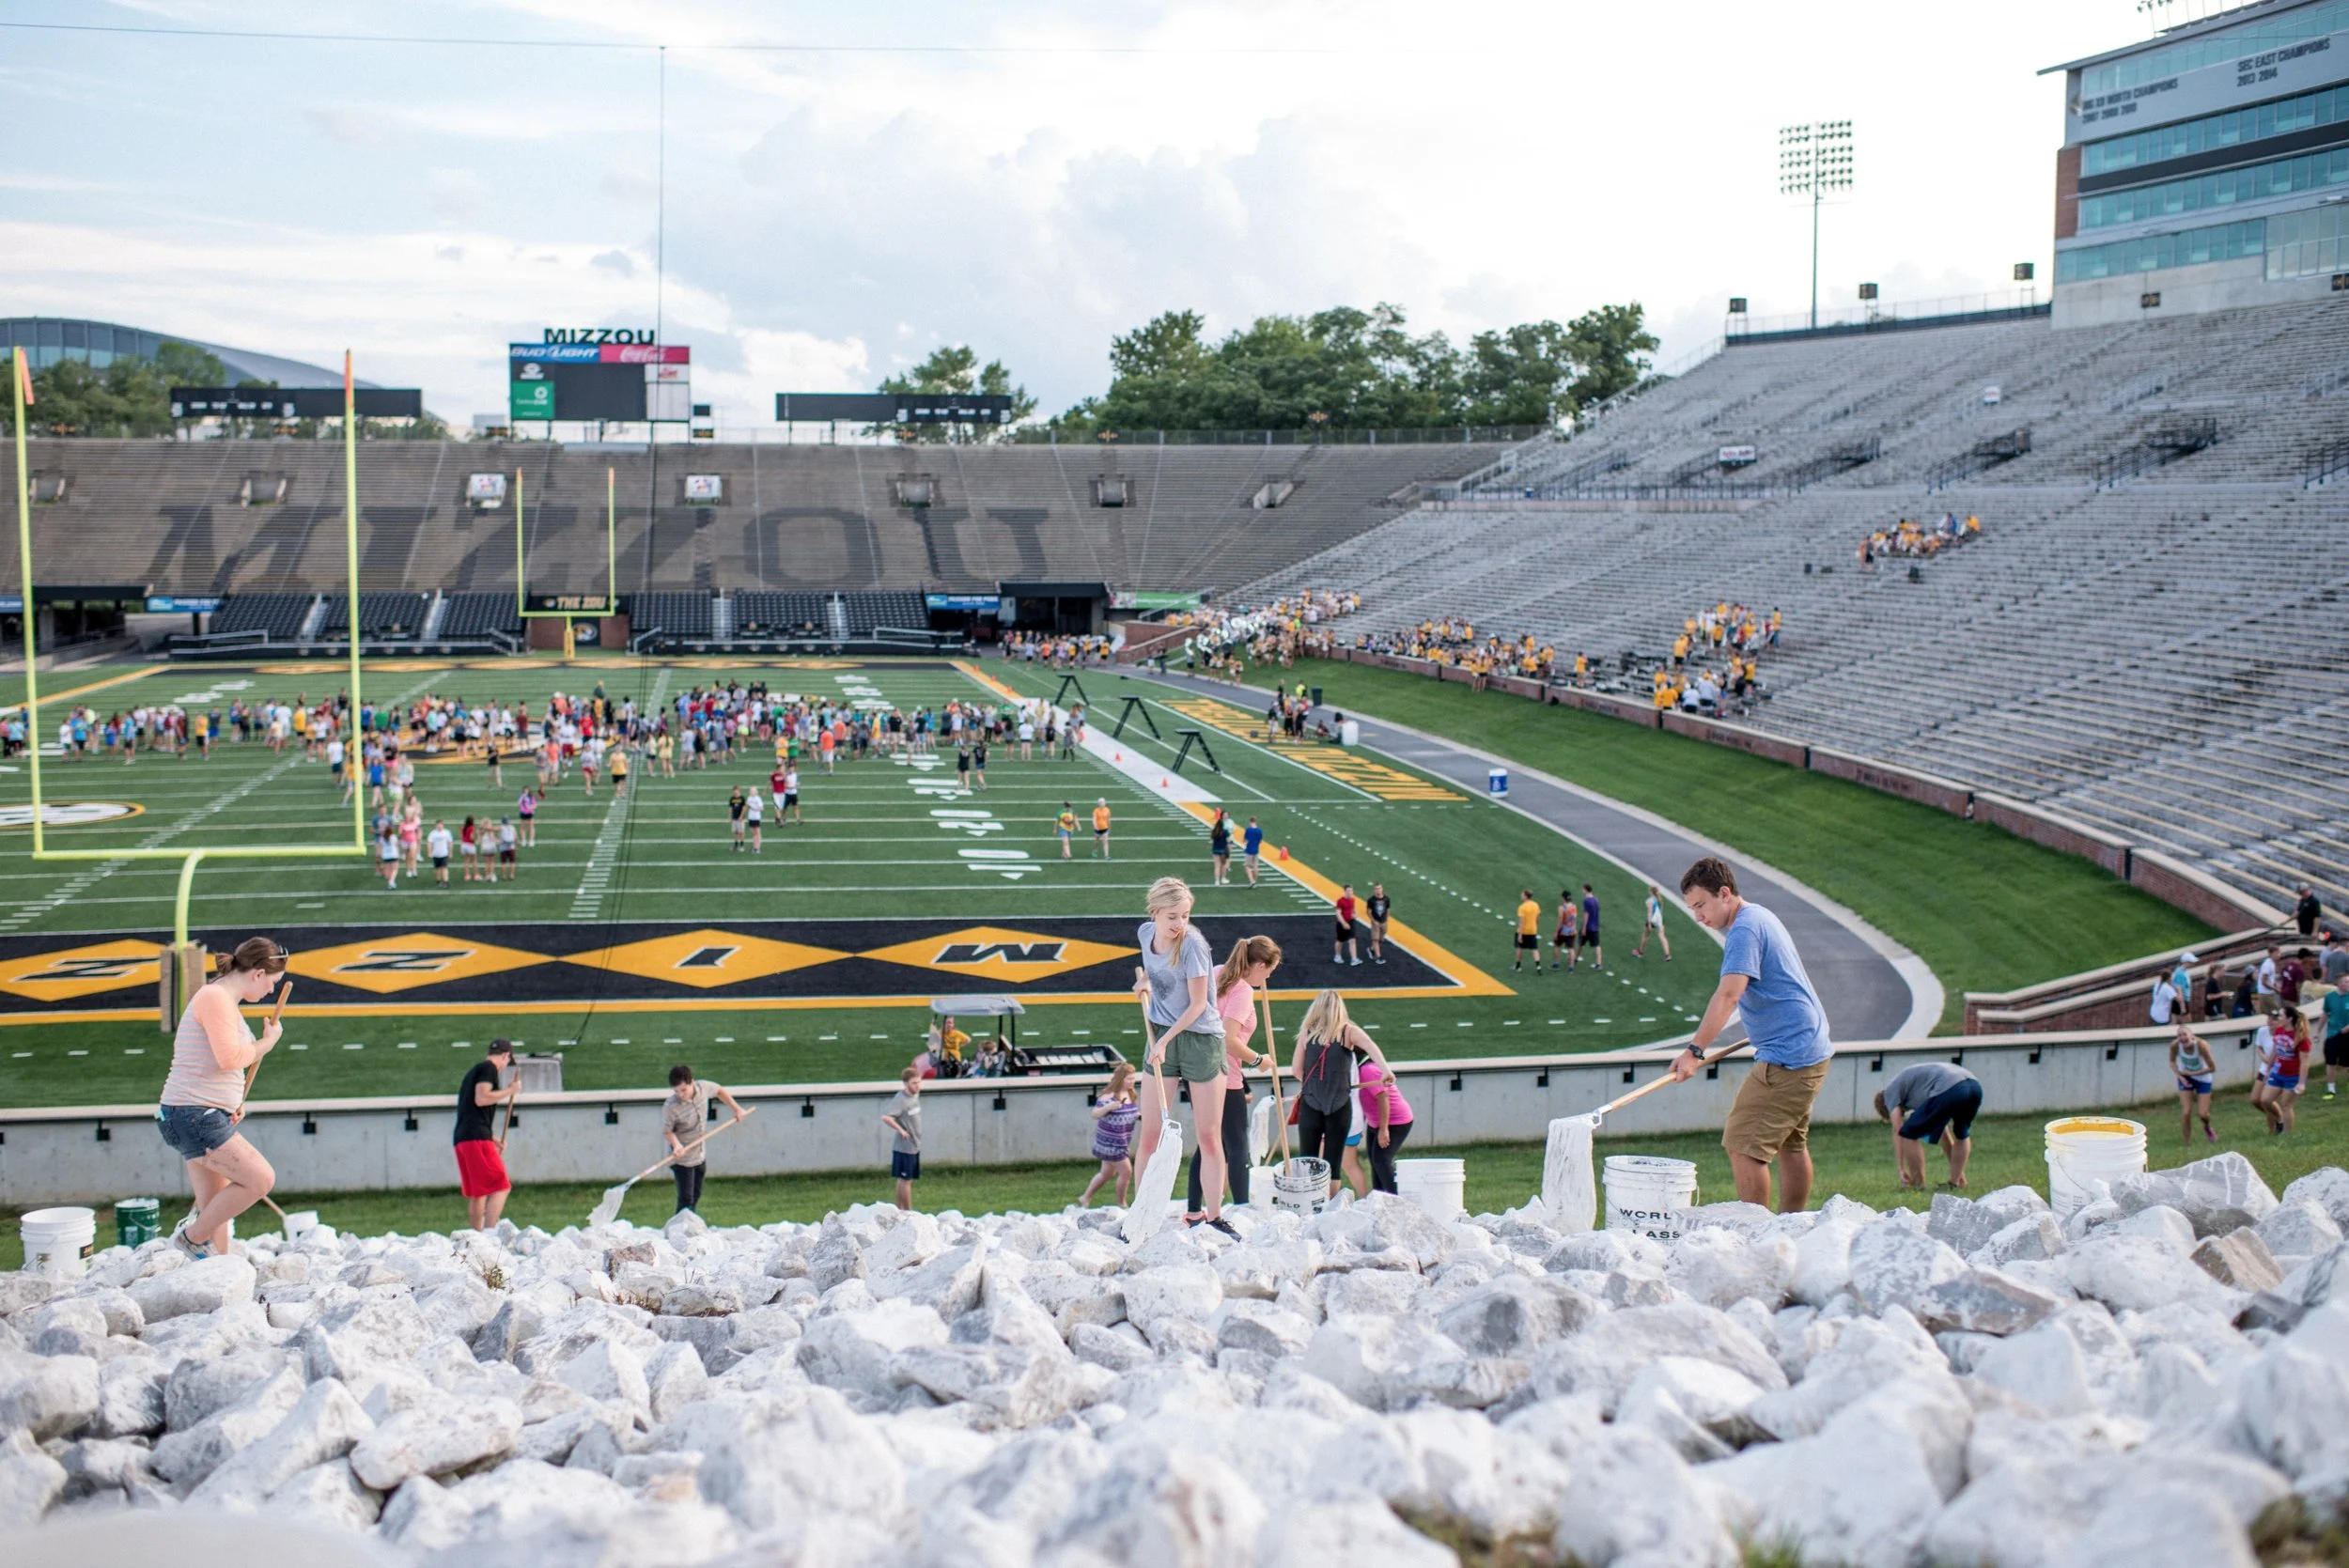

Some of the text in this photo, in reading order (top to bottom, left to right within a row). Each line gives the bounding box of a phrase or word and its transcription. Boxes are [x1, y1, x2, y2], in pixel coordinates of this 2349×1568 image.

[2237, 58, 2254, 72] SEC
[2256, 52, 2278, 69] EAST
[544, 329, 655, 345] MIZZOU
[510, 346, 599, 359] BUD LIGHT
[556, 597, 582, 610] THE
[1619, 1208, 1672, 1219] WORL
